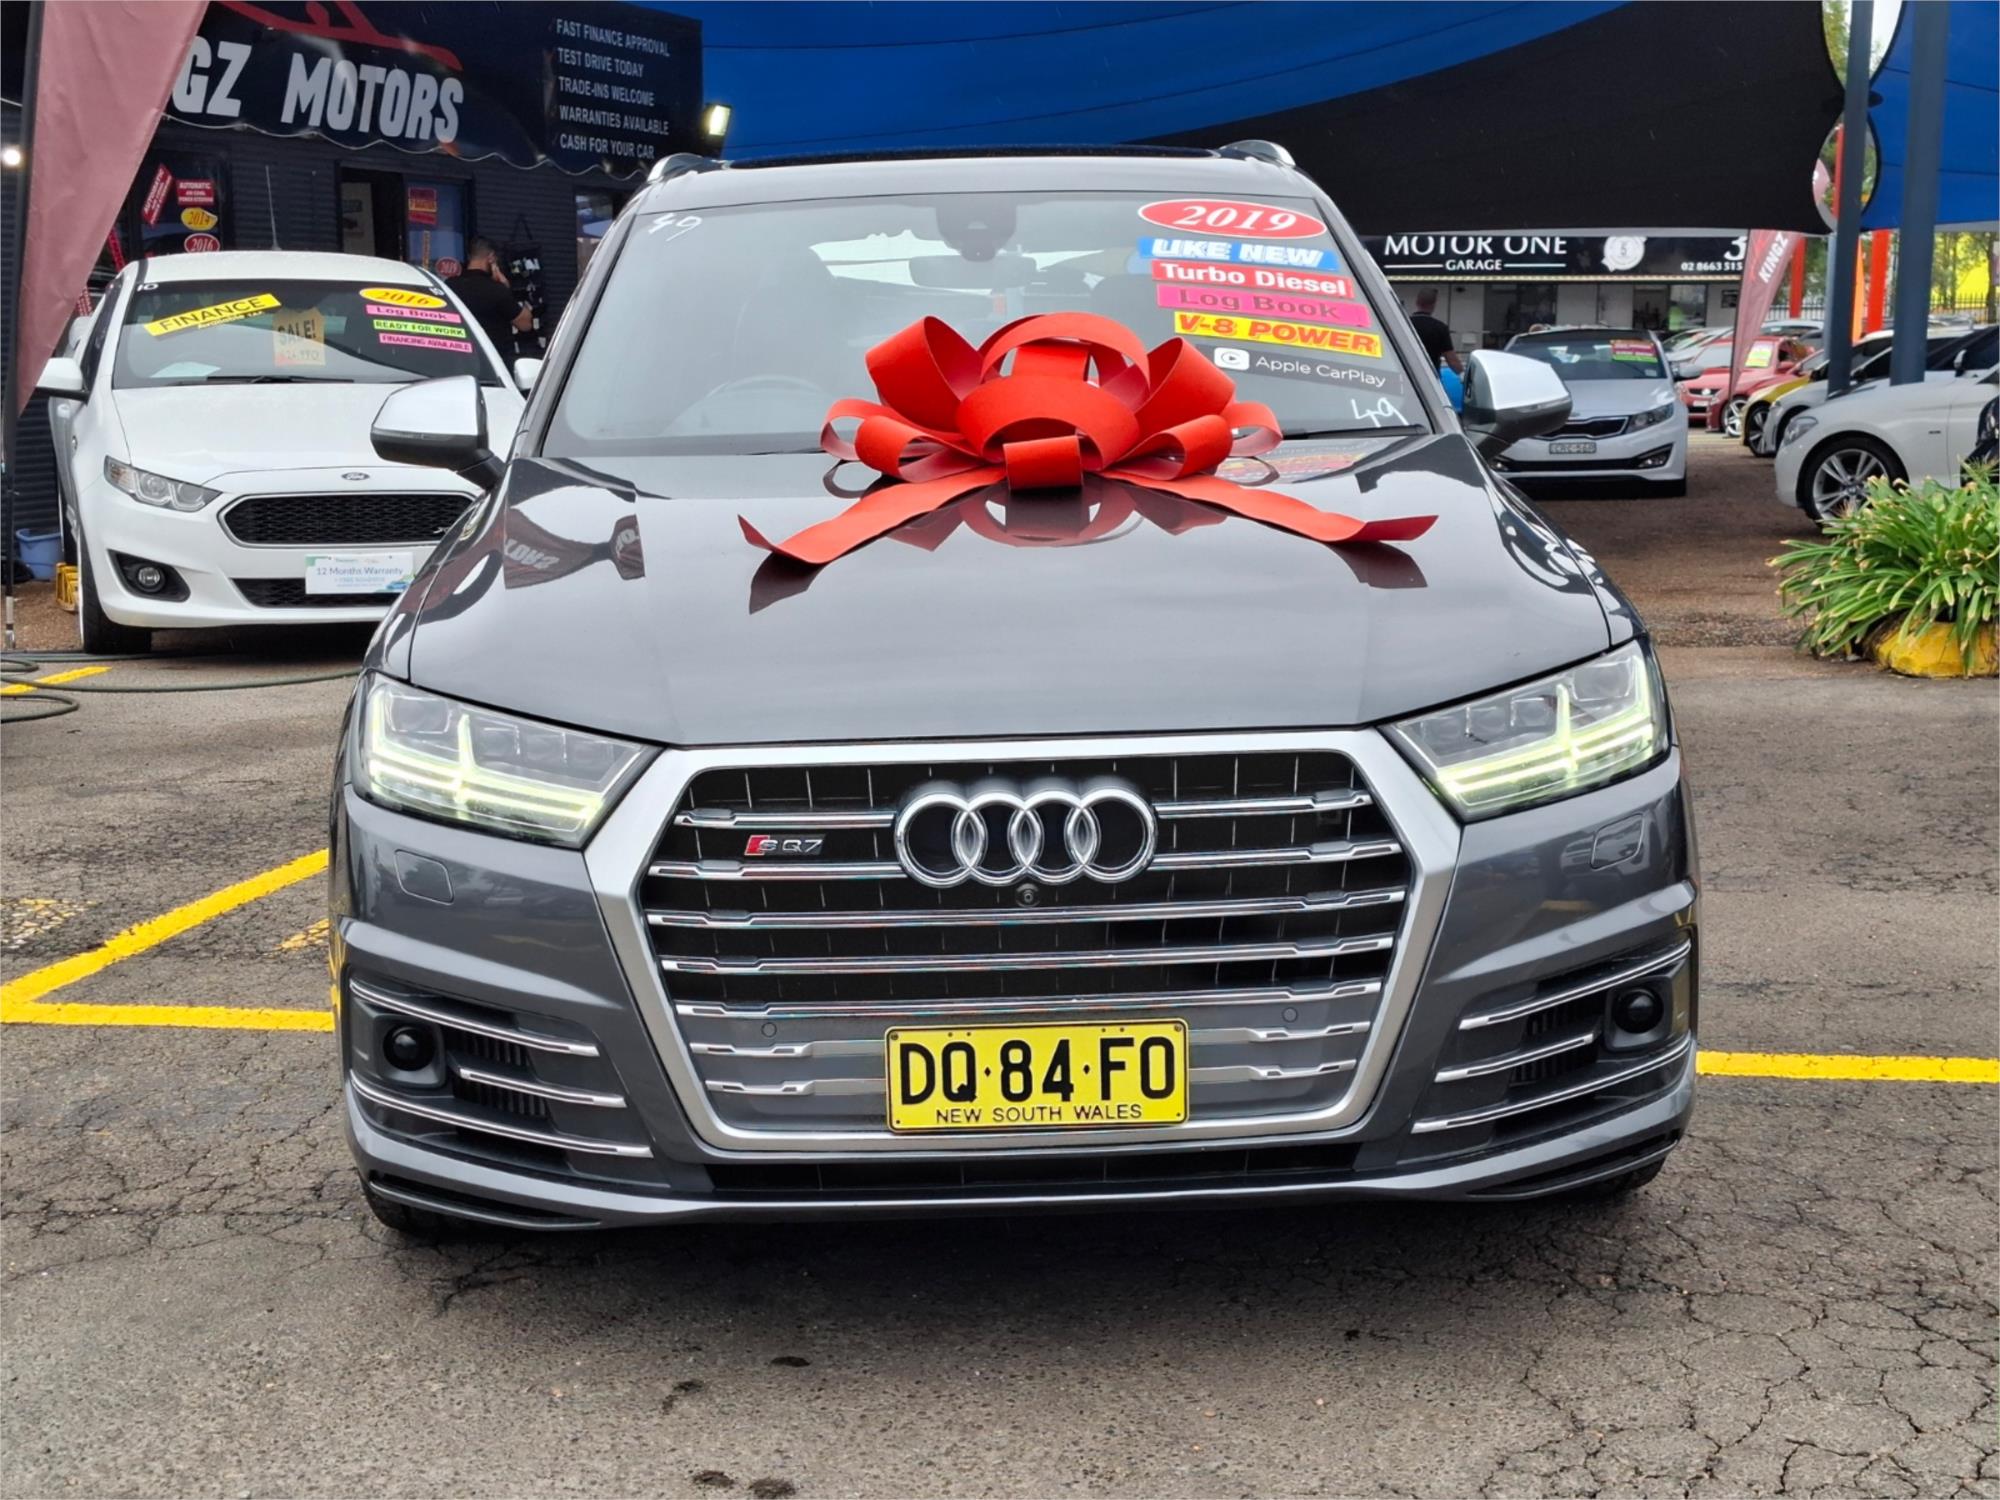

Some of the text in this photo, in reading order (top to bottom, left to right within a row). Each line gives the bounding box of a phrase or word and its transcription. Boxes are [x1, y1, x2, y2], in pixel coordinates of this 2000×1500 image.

[556, 19, 670, 57] FAST FINANCE APPROVAL
[558, 48, 644, 78] TEST DRIVE TODAY
[280, 52, 464, 143] MOTORS
[558, 76, 655, 106] TRADE-INS WELCOME
[559, 105, 669, 135] WARRANTIES AVAILABLE
[560, 133, 655, 159] CASH FOR YOUR CAR
[1173, 206, 1297, 232] 2019
[1151, 238, 1325, 268] LIKE NEW
[1445, 258, 1502, 271] GARAGE
[1758, 232, 1789, 284] KINGZ
[1161, 262, 1347, 296] Turbo Diesel
[376, 291, 430, 305] 2016
[1180, 289, 1341, 319] Log Book
[159, 298, 266, 332] FINANCE
[375, 321, 464, 336] READY FOR WORK
[377, 307, 448, 320] Log Book
[277, 319, 317, 346] SALE!
[382, 335, 470, 351] FINANCING AVAILABLE
[1179, 314, 1380, 354] V-8 POWER
[1256, 355, 1386, 388] Apple CarPlay
[317, 566, 403, 576] 12 Months Warranty
[936, 1103, 1143, 1124] NEW SOUTH WALES
